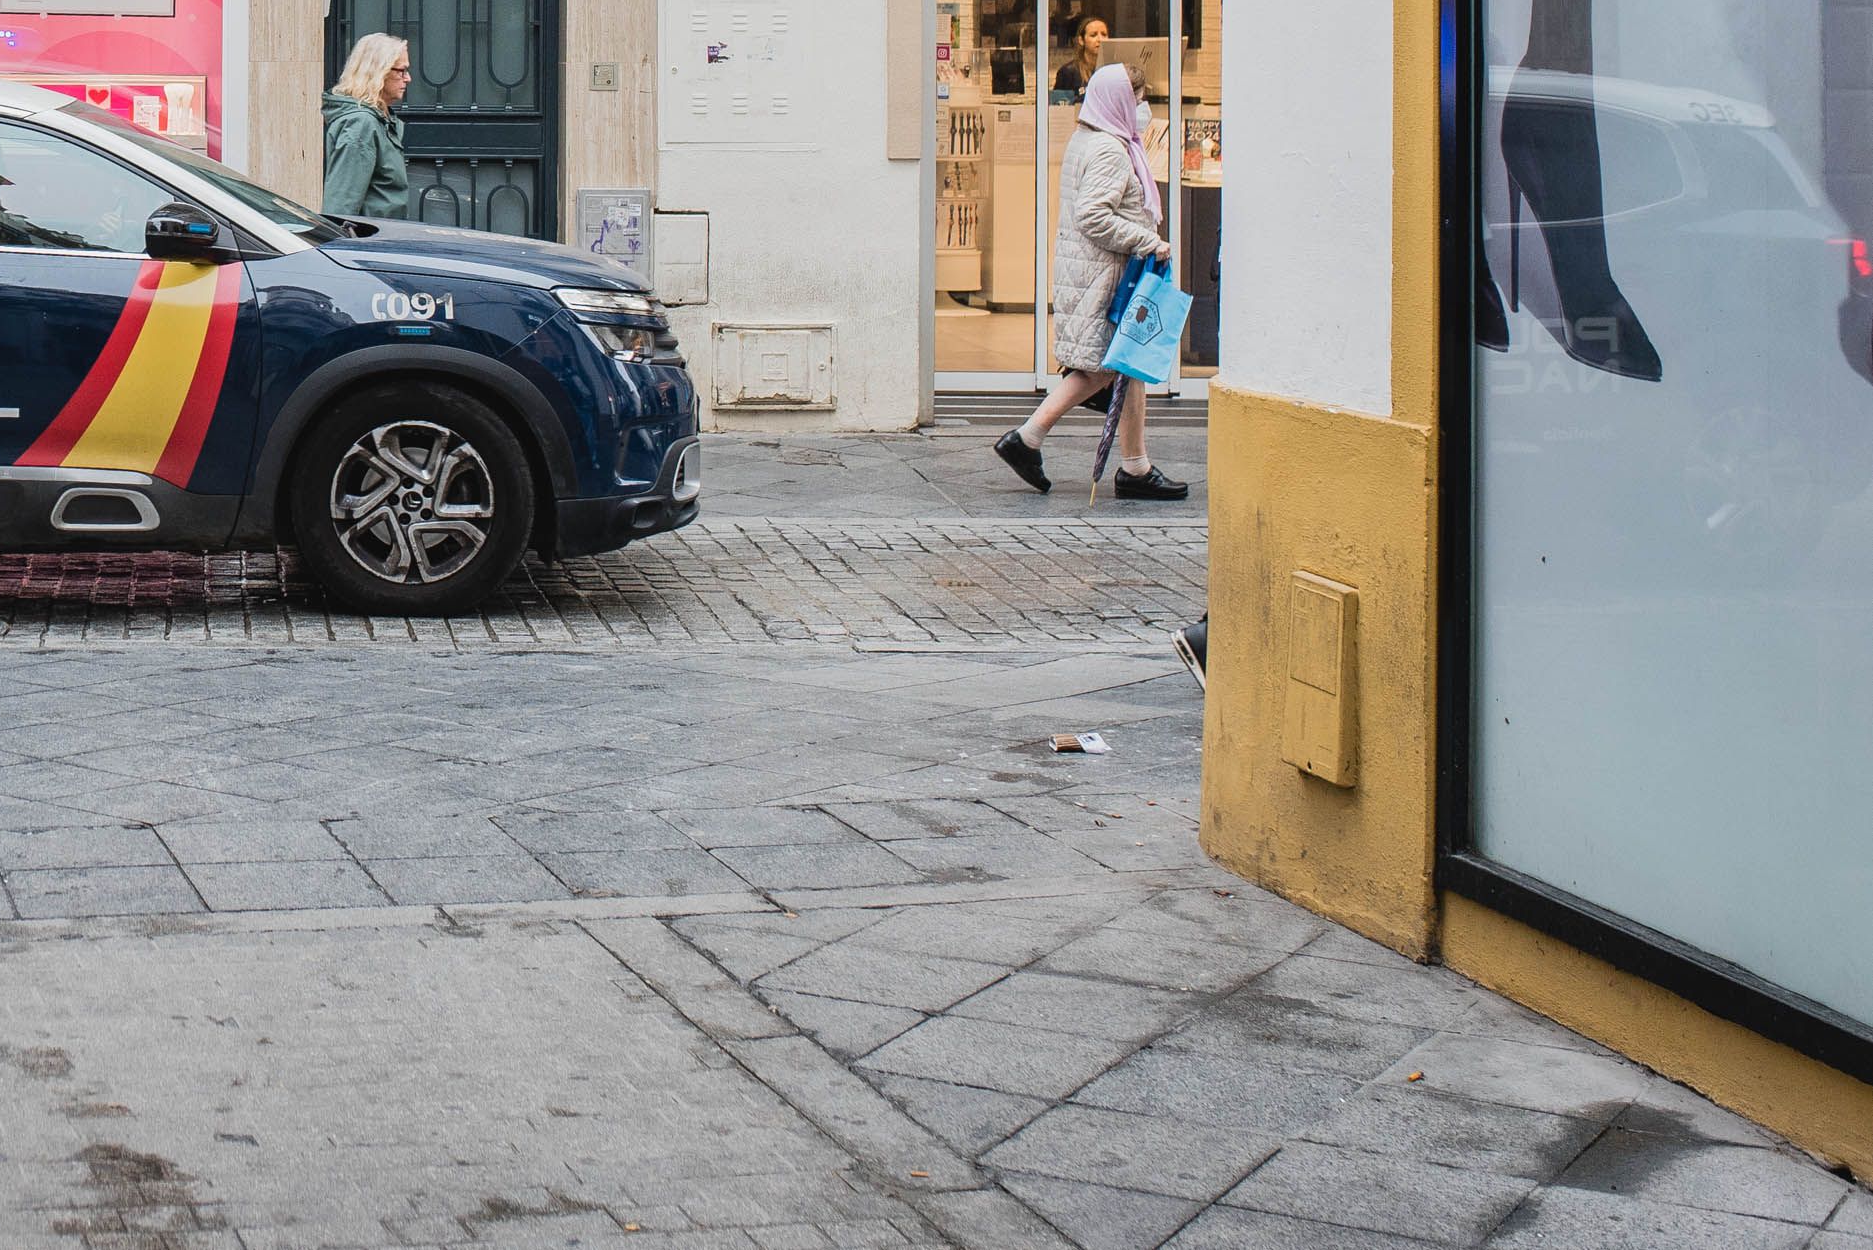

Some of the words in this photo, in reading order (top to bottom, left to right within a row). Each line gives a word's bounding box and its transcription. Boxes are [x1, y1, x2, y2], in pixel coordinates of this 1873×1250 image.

[1187, 121, 1220, 130] HAPPY
[1188, 131, 1220, 141] 2024
[386, 292, 455, 320] 091
